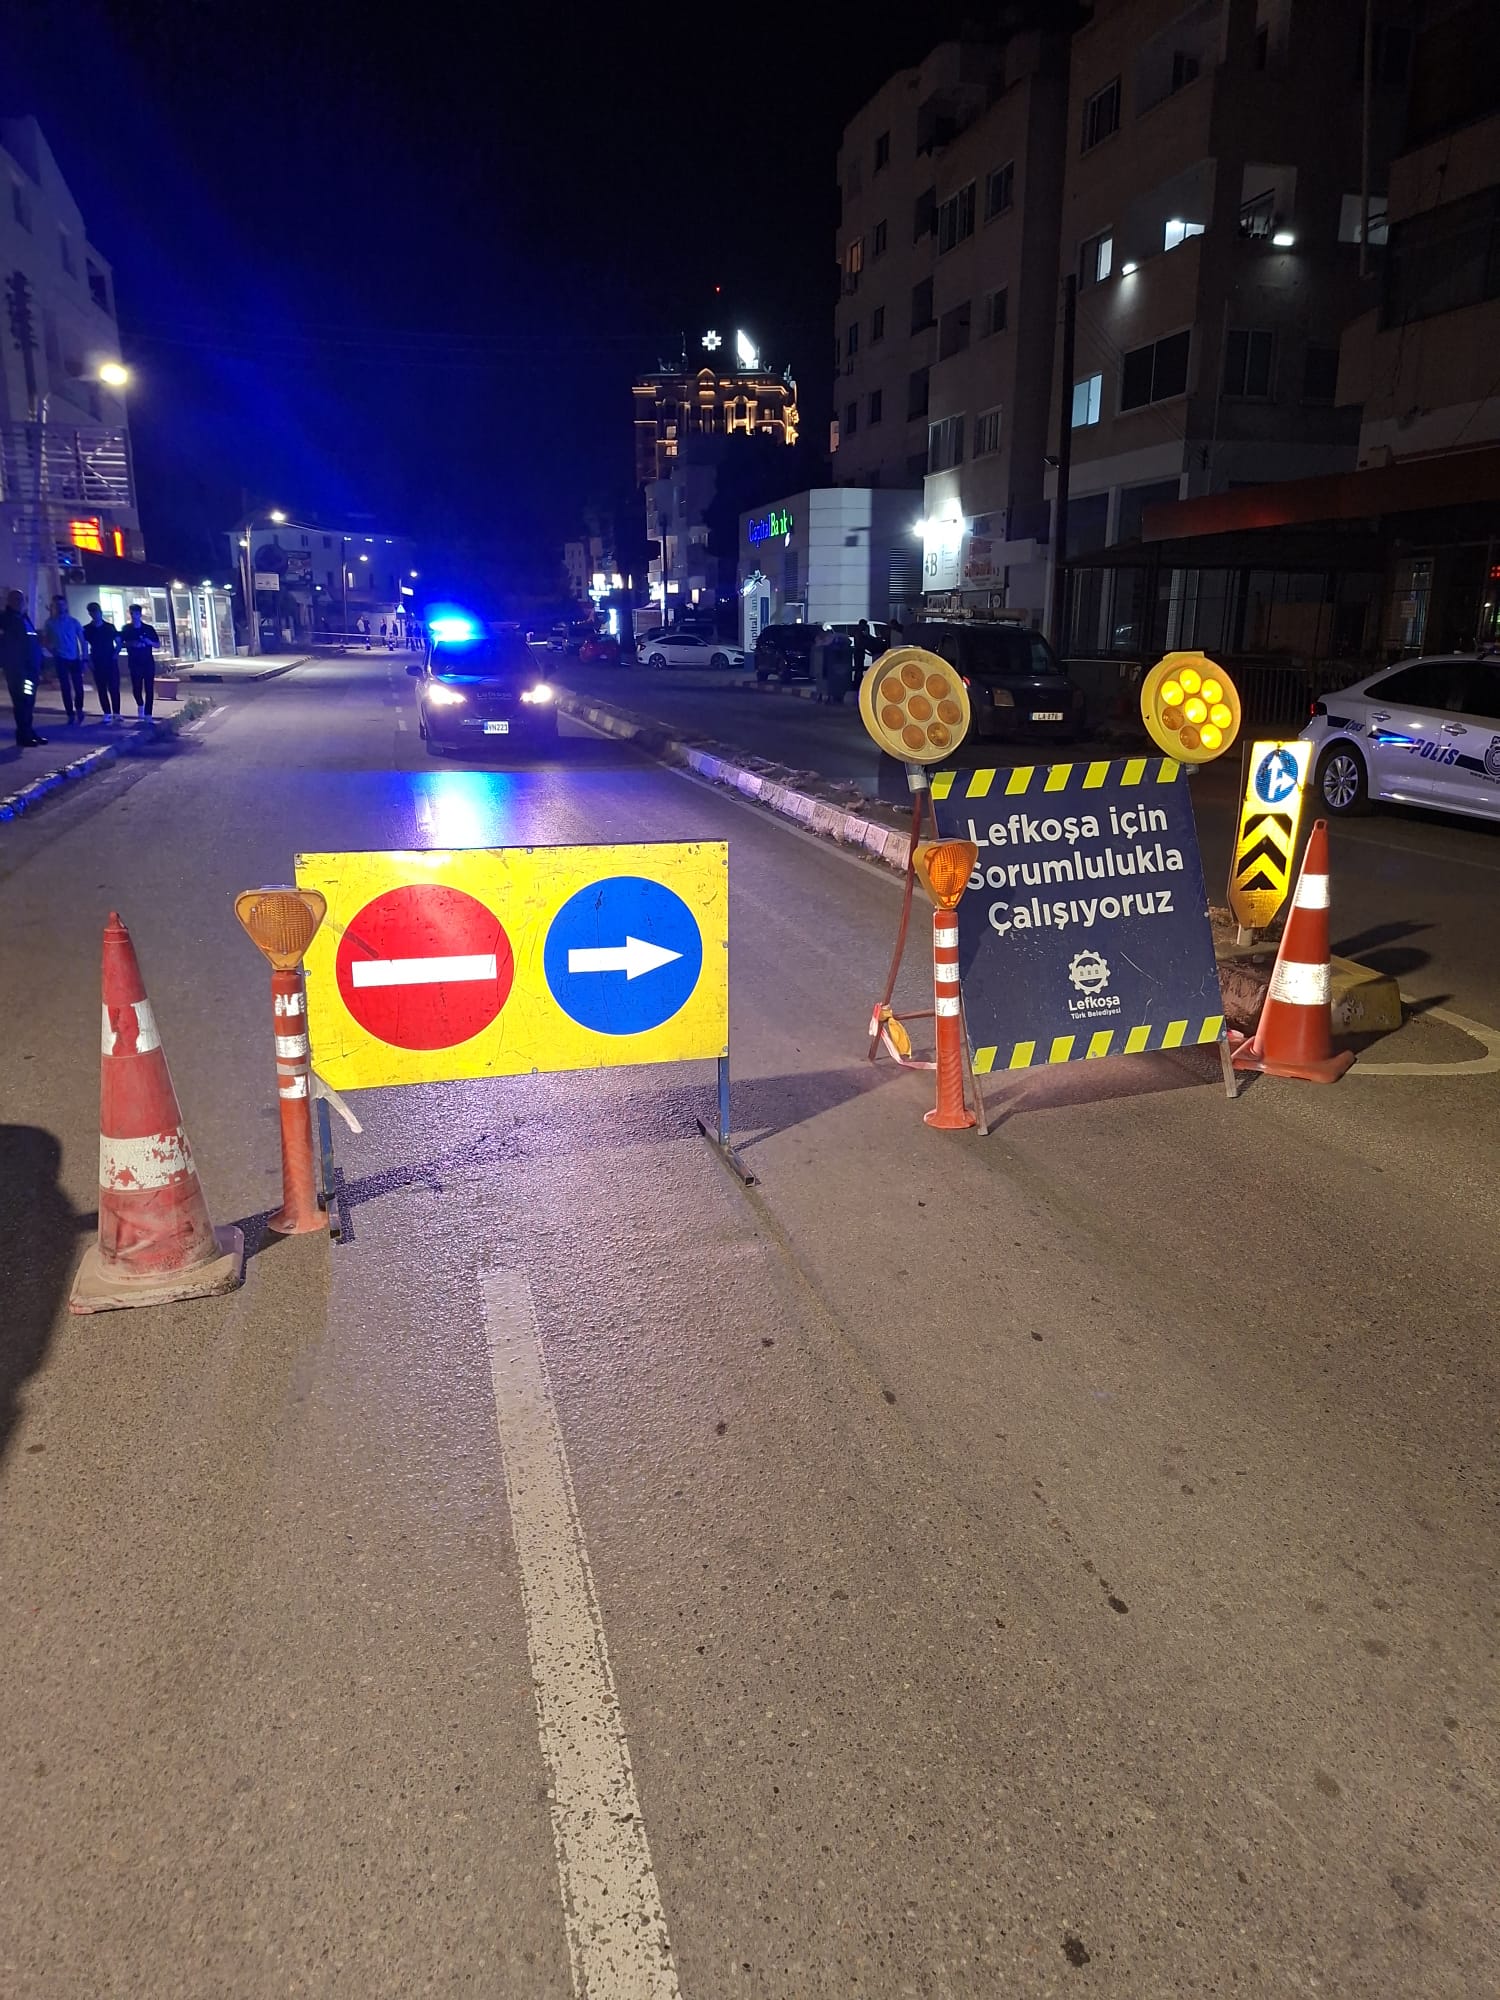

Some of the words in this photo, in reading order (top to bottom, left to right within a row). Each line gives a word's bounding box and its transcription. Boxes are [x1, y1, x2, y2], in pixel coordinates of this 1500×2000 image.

[967, 813, 1100, 846] Lefkoşa
[1109, 803, 1168, 840] için
[966, 843, 1184, 891] Sorumlulukla
[988, 890, 1174, 937] Çalışıyoruz
[1068, 995, 1121, 1012] Lefkoşa
[1070, 1011, 1087, 1021] Türk
[1087, 1006, 1122, 1019] Belediyesi
